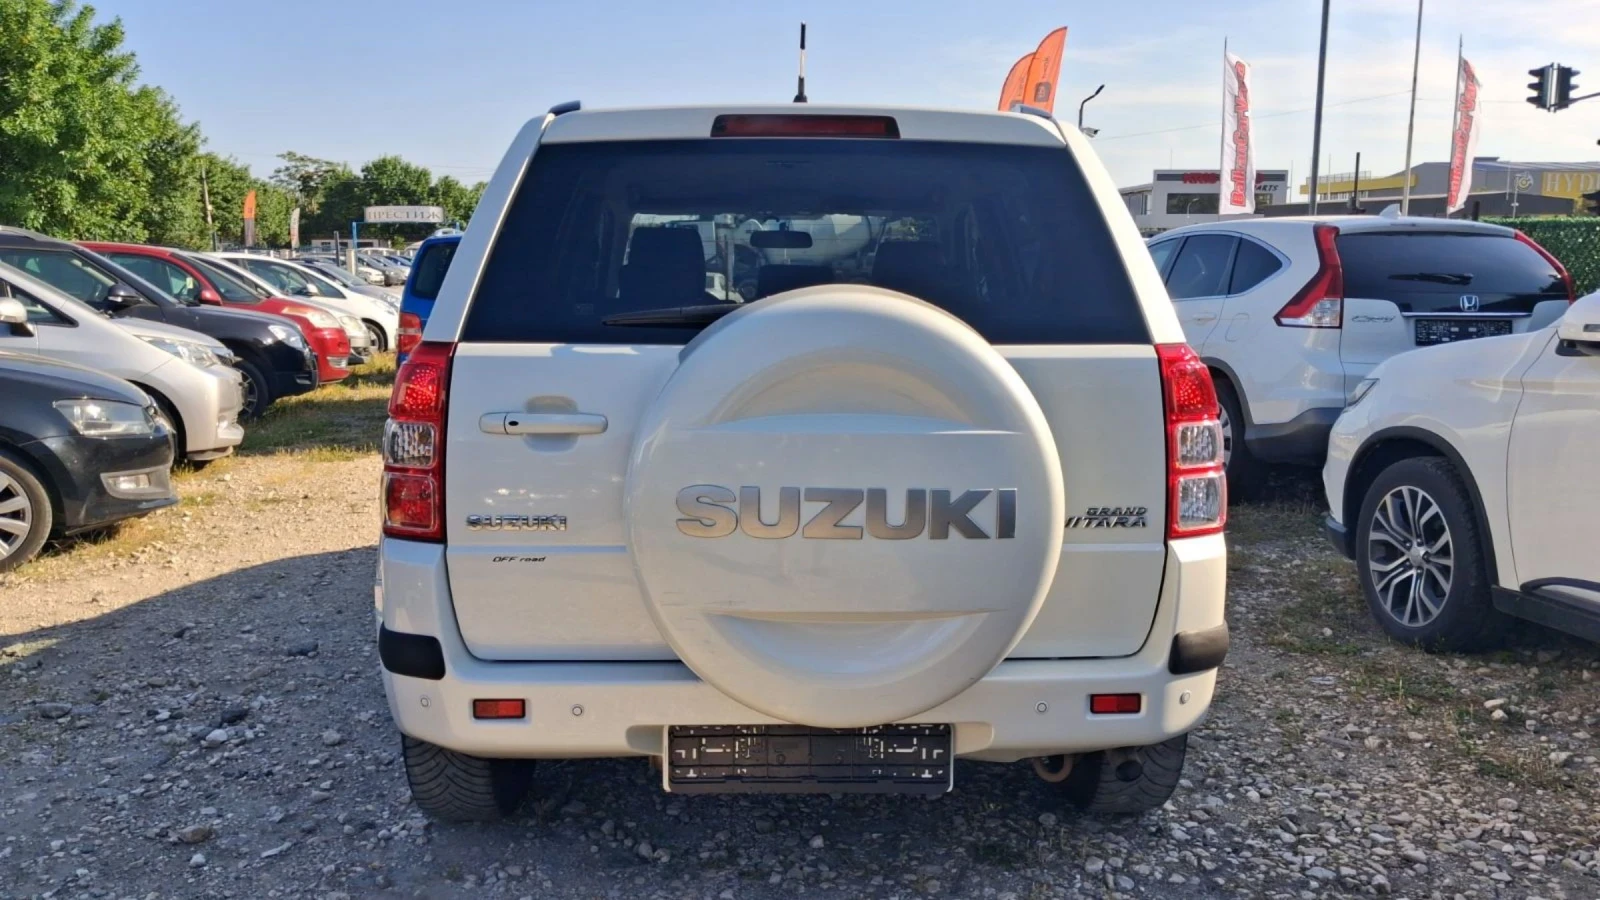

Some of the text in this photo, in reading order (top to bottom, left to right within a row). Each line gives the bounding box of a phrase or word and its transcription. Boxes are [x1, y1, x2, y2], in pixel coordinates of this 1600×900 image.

[1230, 61, 1250, 207] BalkanCarVaa
[1255, 184, 1279, 192] ARTS
[1546, 172, 1600, 193] HYD
[368, 211, 441, 219] ПРЕСТИЖ
[675, 484, 1017, 540] SUZUKI
[1086, 507, 1148, 516] GRAND
[466, 514, 567, 531] SUZUKI
